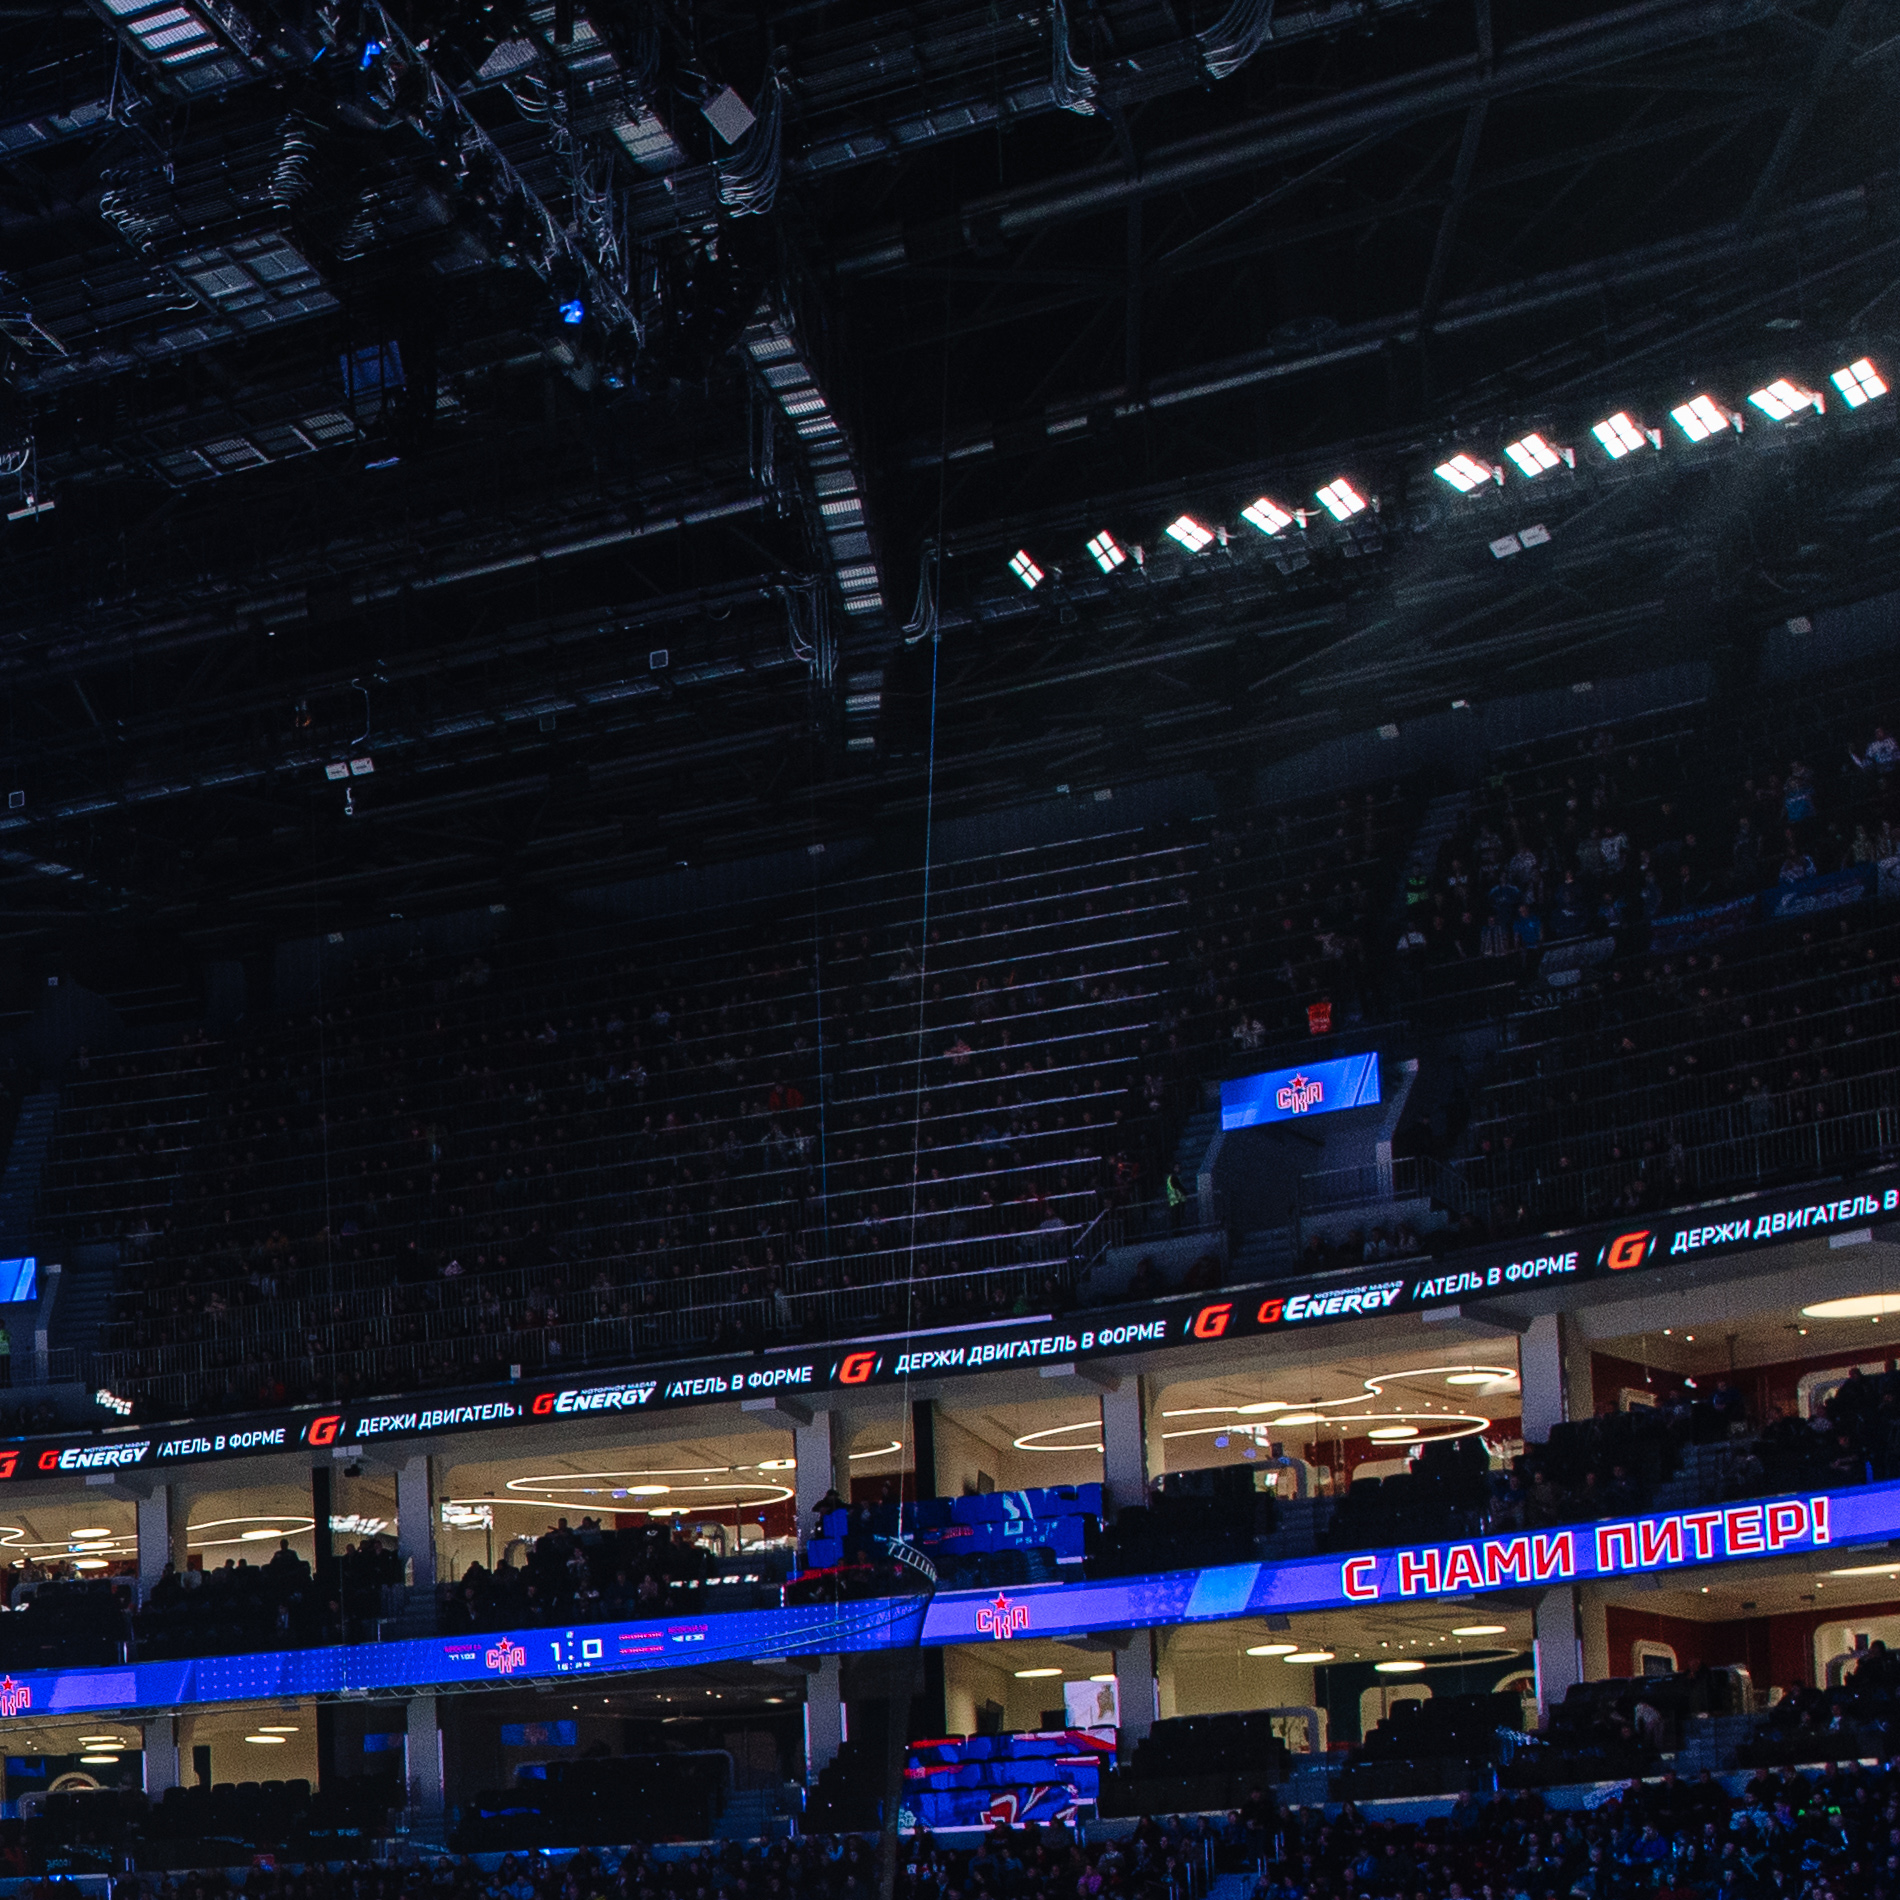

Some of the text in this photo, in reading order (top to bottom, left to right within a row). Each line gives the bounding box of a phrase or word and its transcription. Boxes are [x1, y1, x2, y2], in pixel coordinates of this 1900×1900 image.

[1672, 1219, 1750, 1255] ДЕРЖИ
[1754, 1195, 1878, 1238] ДВИГАТЕЛЬ
[896, 1320, 1166, 1375] ДЕРЖИ ДВИГАТЕЛЬ В ФОРМЕ
[1341, 1496, 1832, 1600] С НАМИ ПИТЕР!
